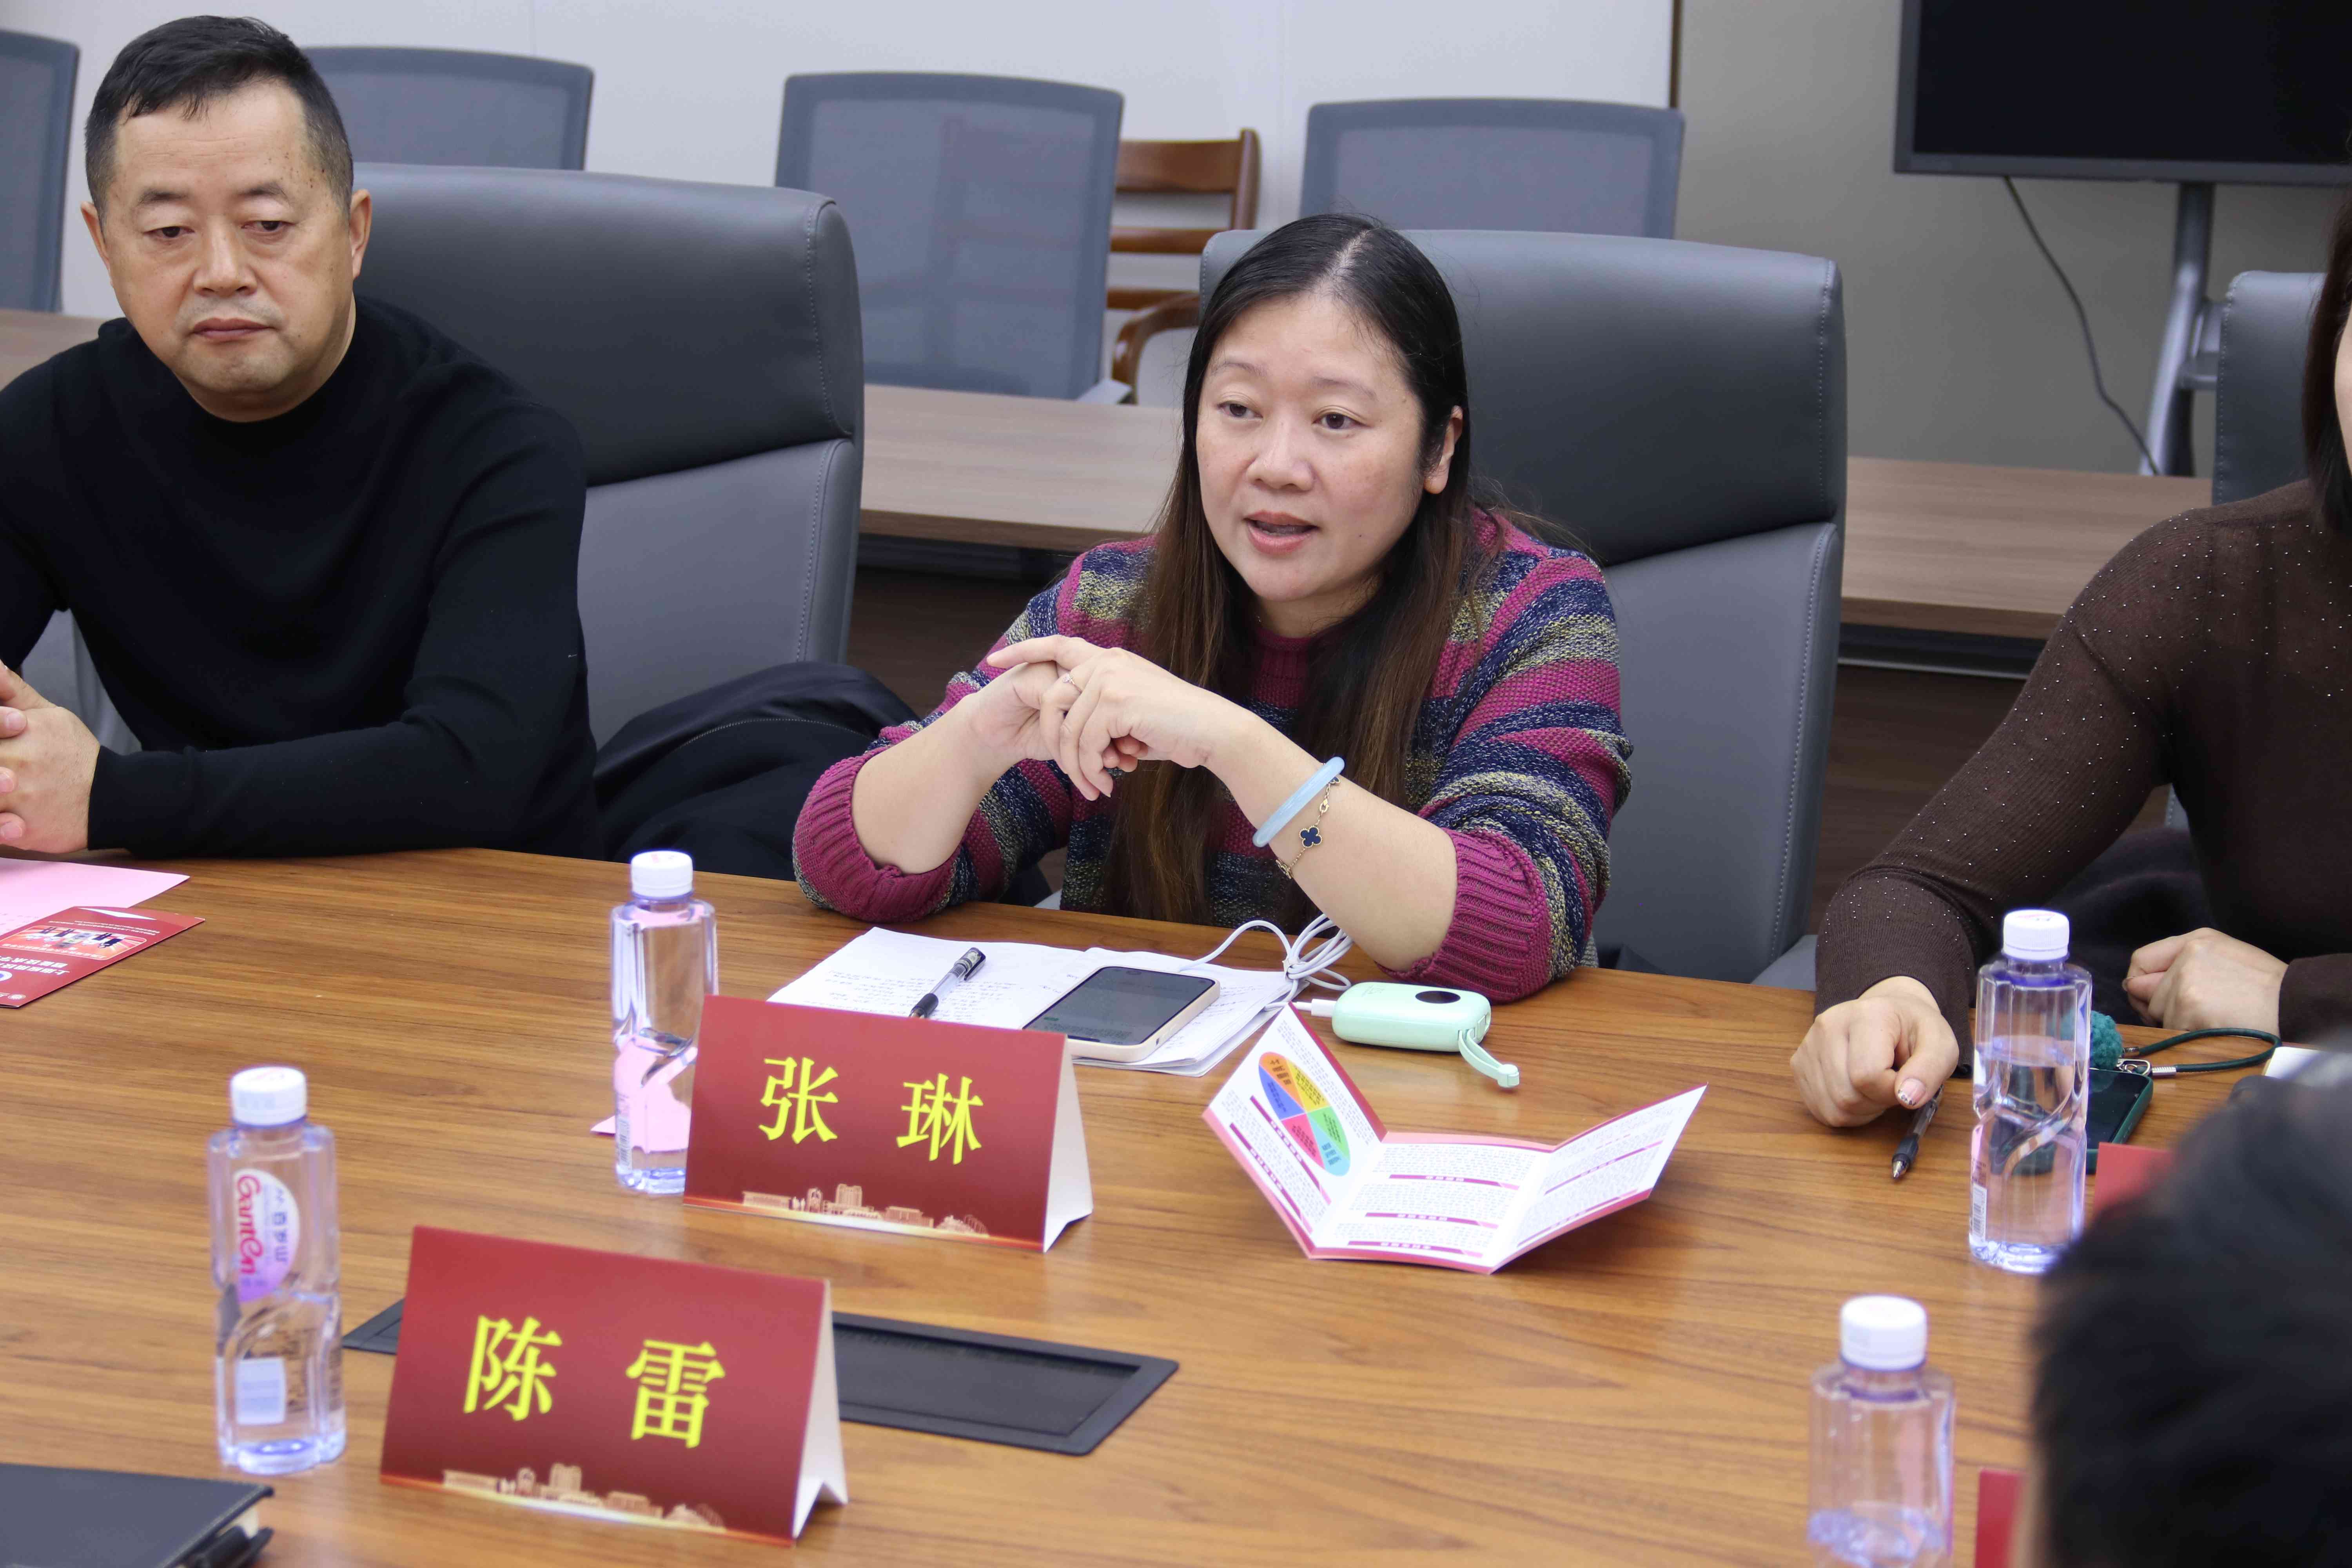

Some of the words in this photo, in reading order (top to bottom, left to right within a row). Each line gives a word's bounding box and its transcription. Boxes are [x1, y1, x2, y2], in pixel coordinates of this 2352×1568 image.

[759, 1057, 838, 1143] 张
[897, 1073, 983, 1164] 琳
[465, 1316, 561, 1420] 陈
[626, 1340, 725, 1447] 雷
